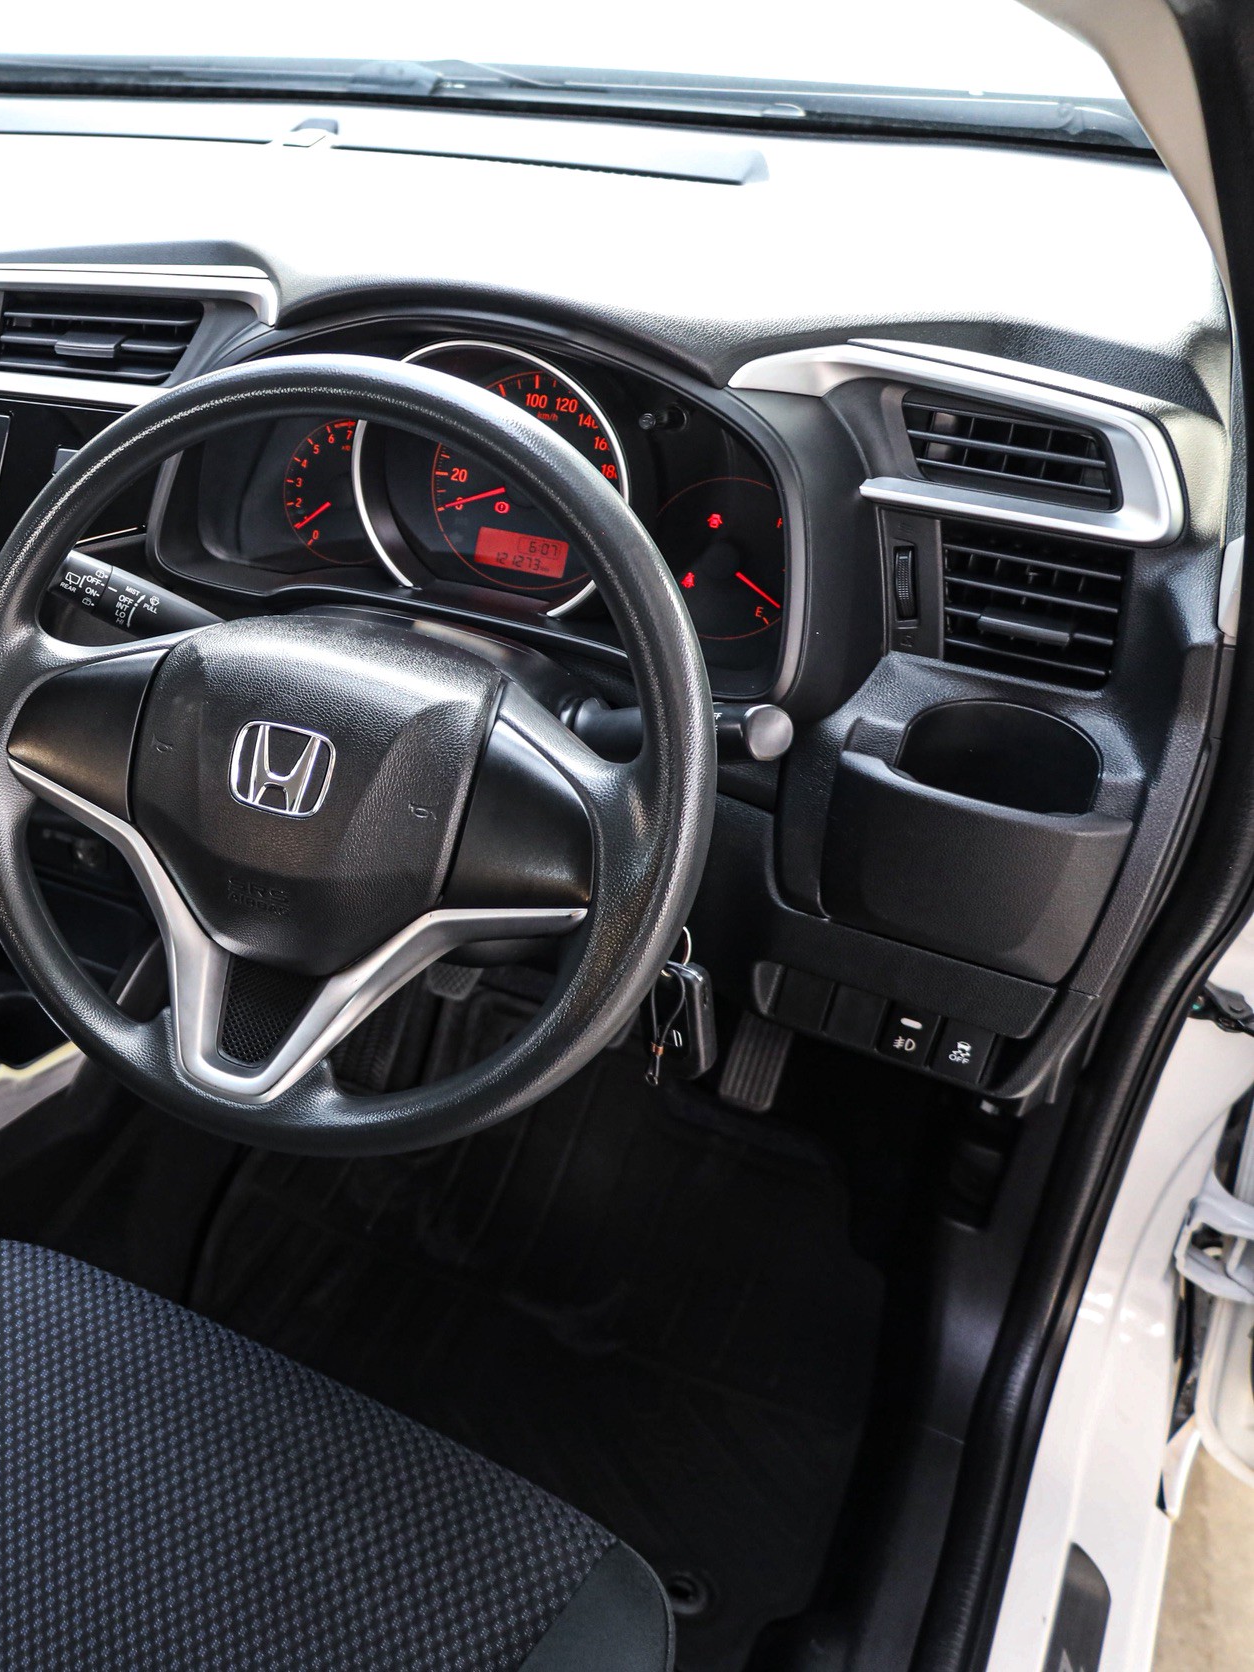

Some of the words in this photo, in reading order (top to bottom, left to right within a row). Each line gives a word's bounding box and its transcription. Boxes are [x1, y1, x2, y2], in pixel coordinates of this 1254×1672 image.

[525, 393, 548, 409] 100
[555, 397, 579, 413] 120
[537, 411, 559, 422] km/h
[328, 434, 335, 444] 6
[346, 430, 353, 440] 7
[594, 436, 610, 451] 16
[313, 444, 320, 455] 5
[301, 459, 308, 468] 4
[450, 467, 468, 482] 20
[601, 464, 618, 479] 18
[295, 477, 303, 487] 3
[295, 497, 303, 508] 2
[312, 529, 319, 540] 0
[86, 575, 101, 586] OFF
[59, 581, 77, 593] REAR
[85, 587, 97, 597] ON
[125, 585, 141, 597] MIST
[118, 594, 134, 605] OFF
[115, 601, 129, 612] INT
[143, 603, 158, 614] PULL
[755, 606, 764, 618] E
[114, 609, 126, 619] LO
[948, 1053, 970, 1064] OFF
